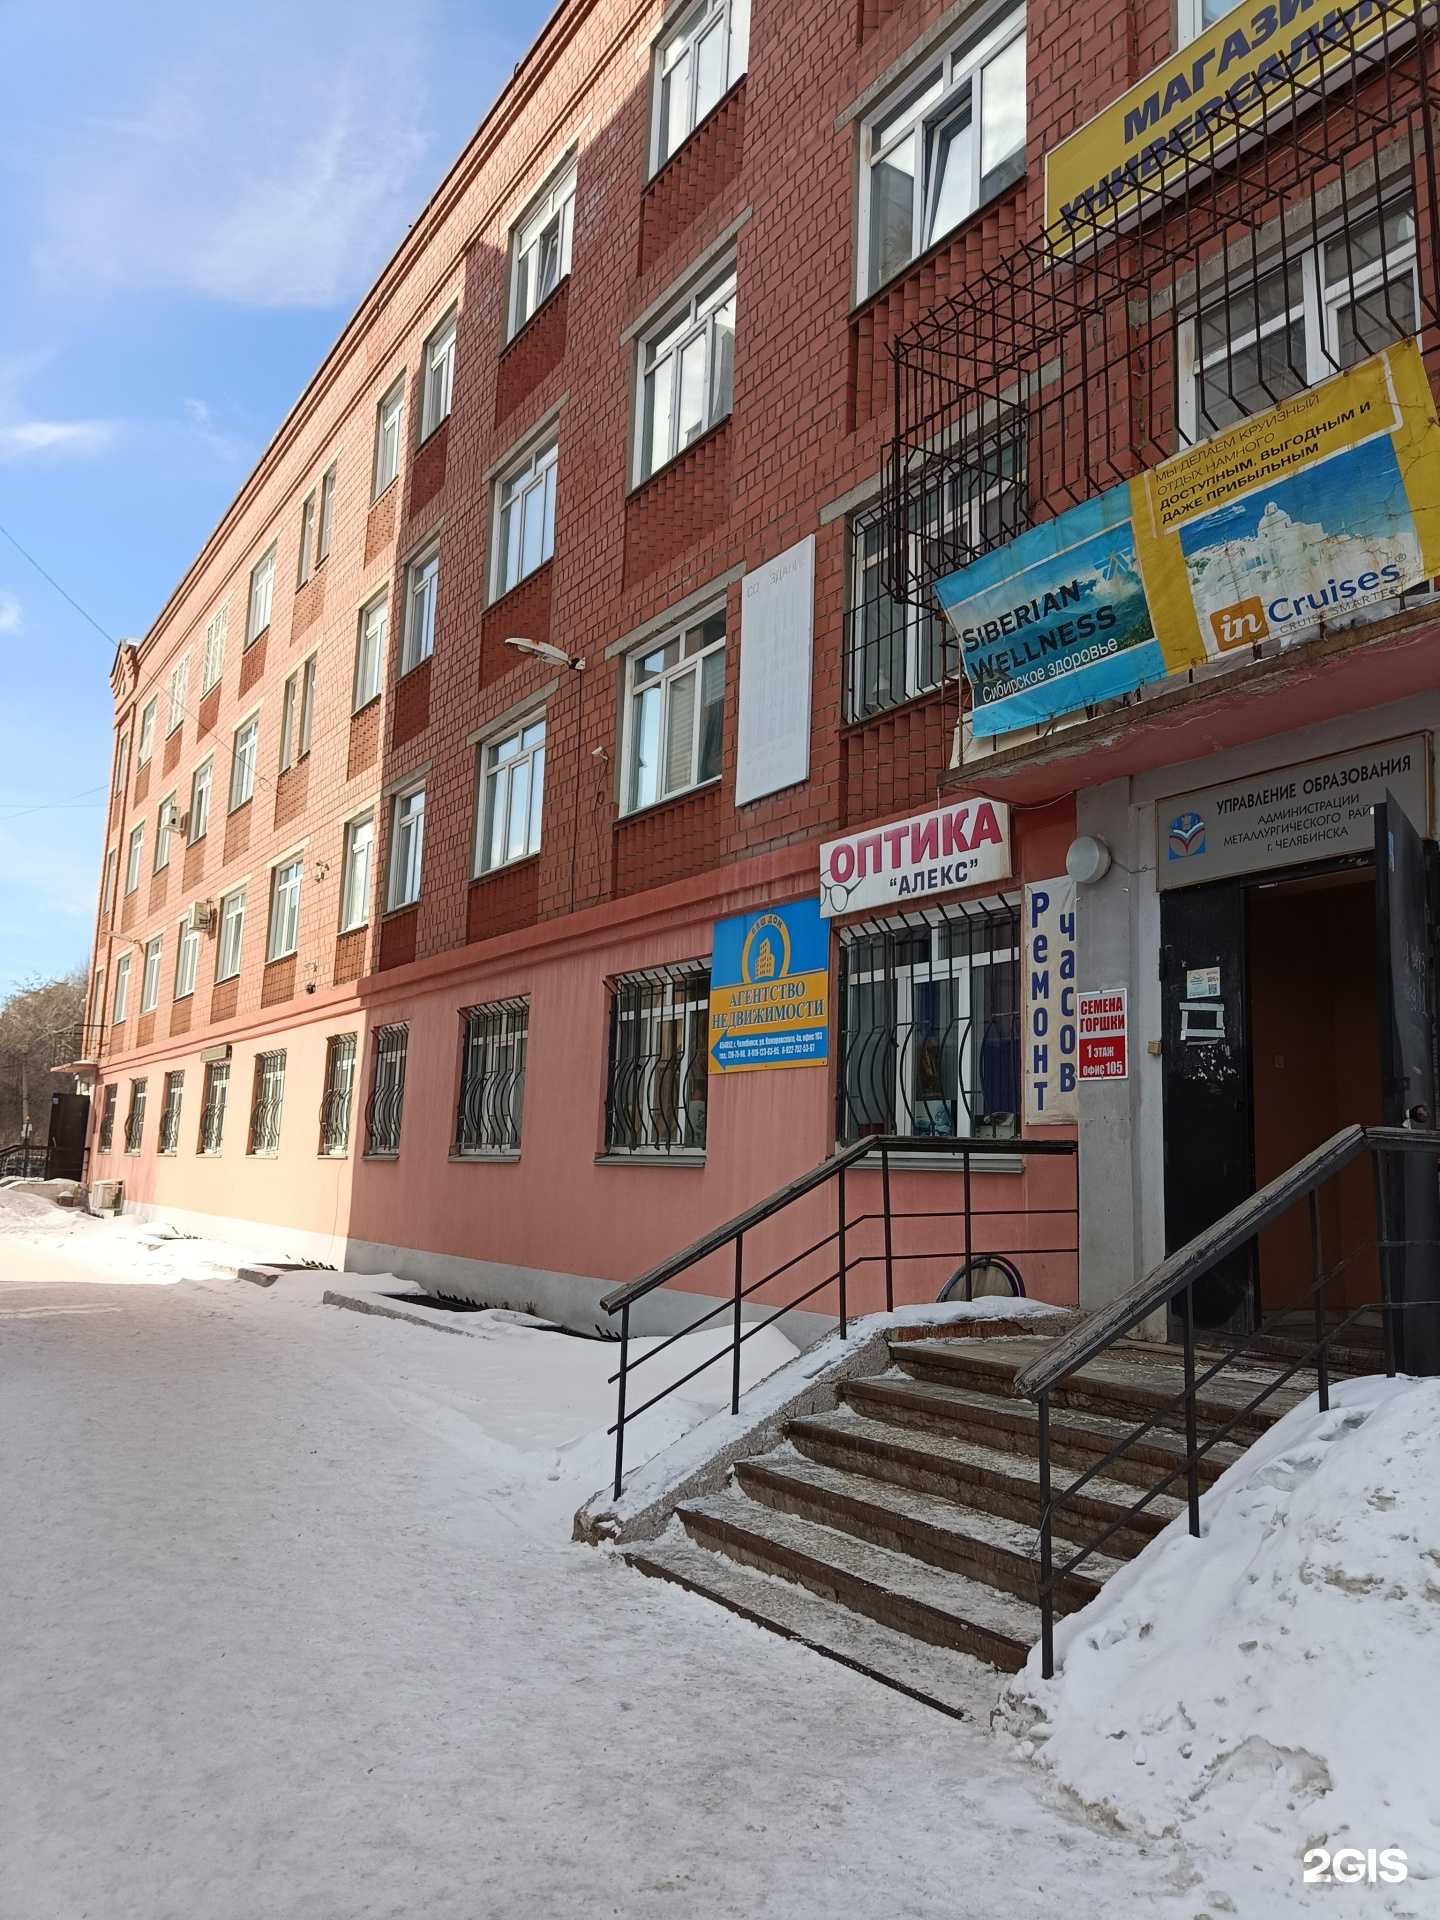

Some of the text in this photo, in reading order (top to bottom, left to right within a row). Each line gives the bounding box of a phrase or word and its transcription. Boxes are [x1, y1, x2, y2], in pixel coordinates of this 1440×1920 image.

[1156, 394, 1320, 482] МЫ ДЕЛАЕМ КРУИЗНЫЙ
[1260, 410, 1355, 461] ВЫГОДНЫМ
[1360, 401, 1371, 414] И
[1157, 432, 1275, 496] ОТДЫХ НАМНОГО
[1162, 442, 1319, 524] ДАЖЕ ПРИБЫЛЬНЫМ
[962, 579, 1081, 653] SIBERIAN
[970, 605, 1117, 682] WELLNESS
[983, 637, 1118, 704] Сибирское здоровье
[1217, 755, 1411, 815] УПРАВЛЕНИЕ ОБРАЗОВАНИЯ
[1257, 793, 1360, 825] АДМИНИСТРАЦИИ
[829, 802, 1003, 884] ОПТИКА
[1224, 806, 1372, 847] МЕТАЛЛУРГИЧЕСКОГО РАЙ
[1275, 826, 1348, 850] ЧЕЛЯБИНСКА
[712, 1000, 824, 1029] НЕДВИЖИМОСТИ
[729, 981, 806, 1007] АГЕНТСТВО
[1081, 997, 1123, 1015] СЕМЕНА
[1080, 1015, 1125, 1032] ГОРШКИ
[1087, 1044, 1092, 1058] 1
[1105, 1061, 1123, 1075] 105
